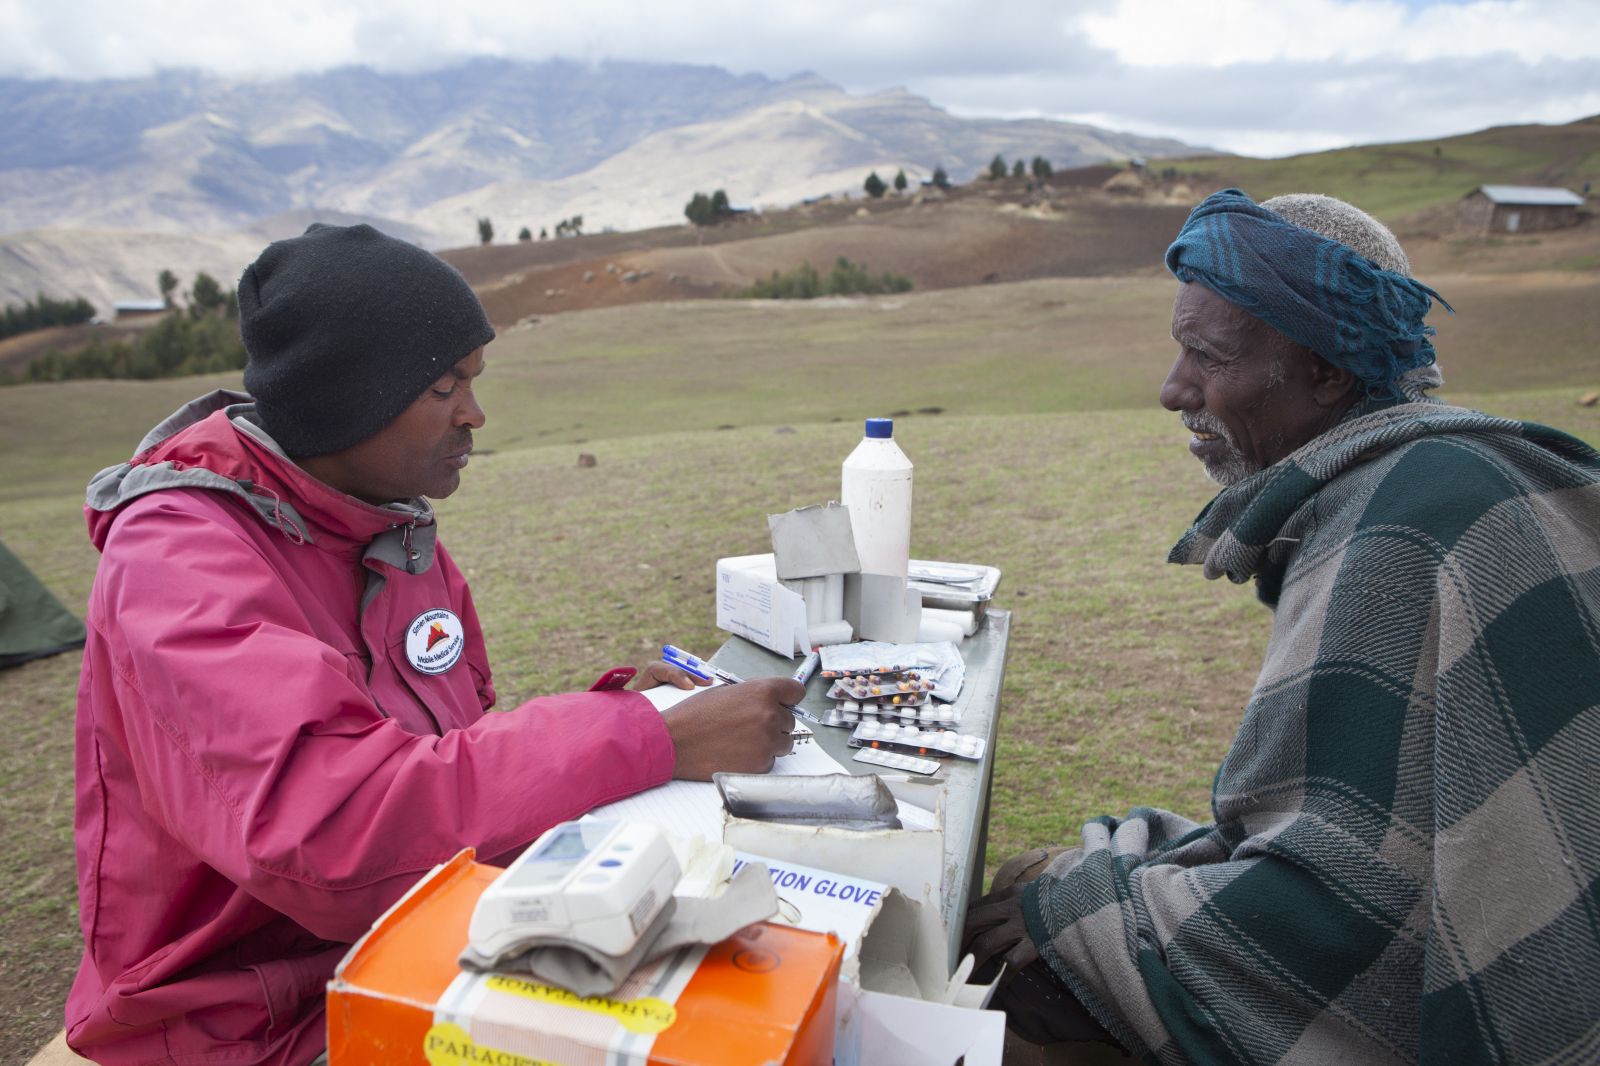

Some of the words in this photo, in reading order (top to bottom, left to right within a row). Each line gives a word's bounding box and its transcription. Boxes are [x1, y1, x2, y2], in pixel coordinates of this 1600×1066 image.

[424, 612, 449, 622] Mountains
[417, 655, 434, 663] Mobile
[434, 648, 449, 661] Medical
[813, 879, 881, 907] GLOVE
